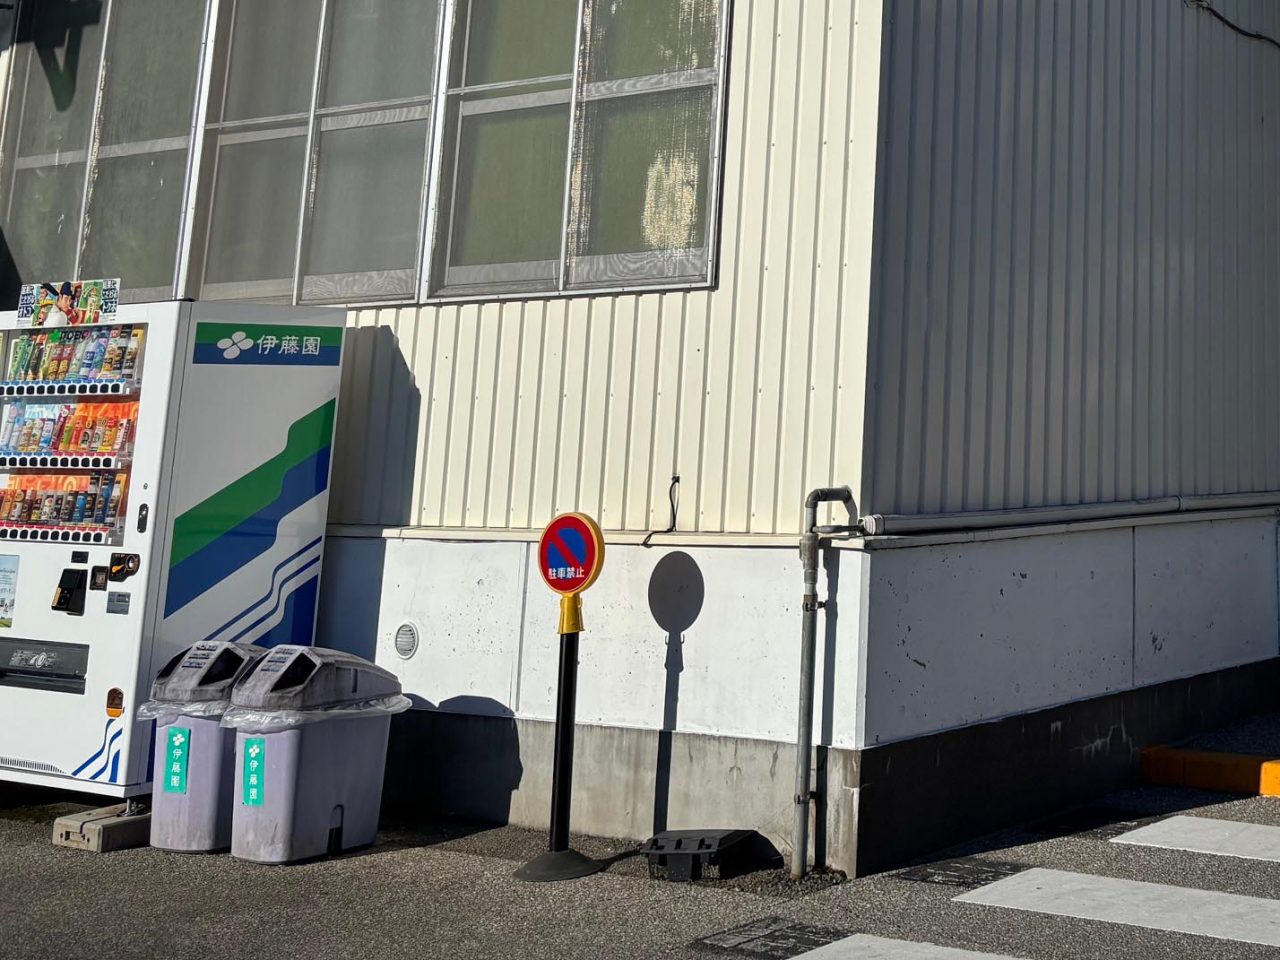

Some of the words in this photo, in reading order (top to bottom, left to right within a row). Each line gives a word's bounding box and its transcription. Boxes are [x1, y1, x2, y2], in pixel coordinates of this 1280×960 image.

[256, 335, 321, 356] 伊藤園
[548, 566, 585, 580] 駐車禁止
[170, 748, 183, 787] 伊藤園
[249, 760, 259, 800] 伊藤園
